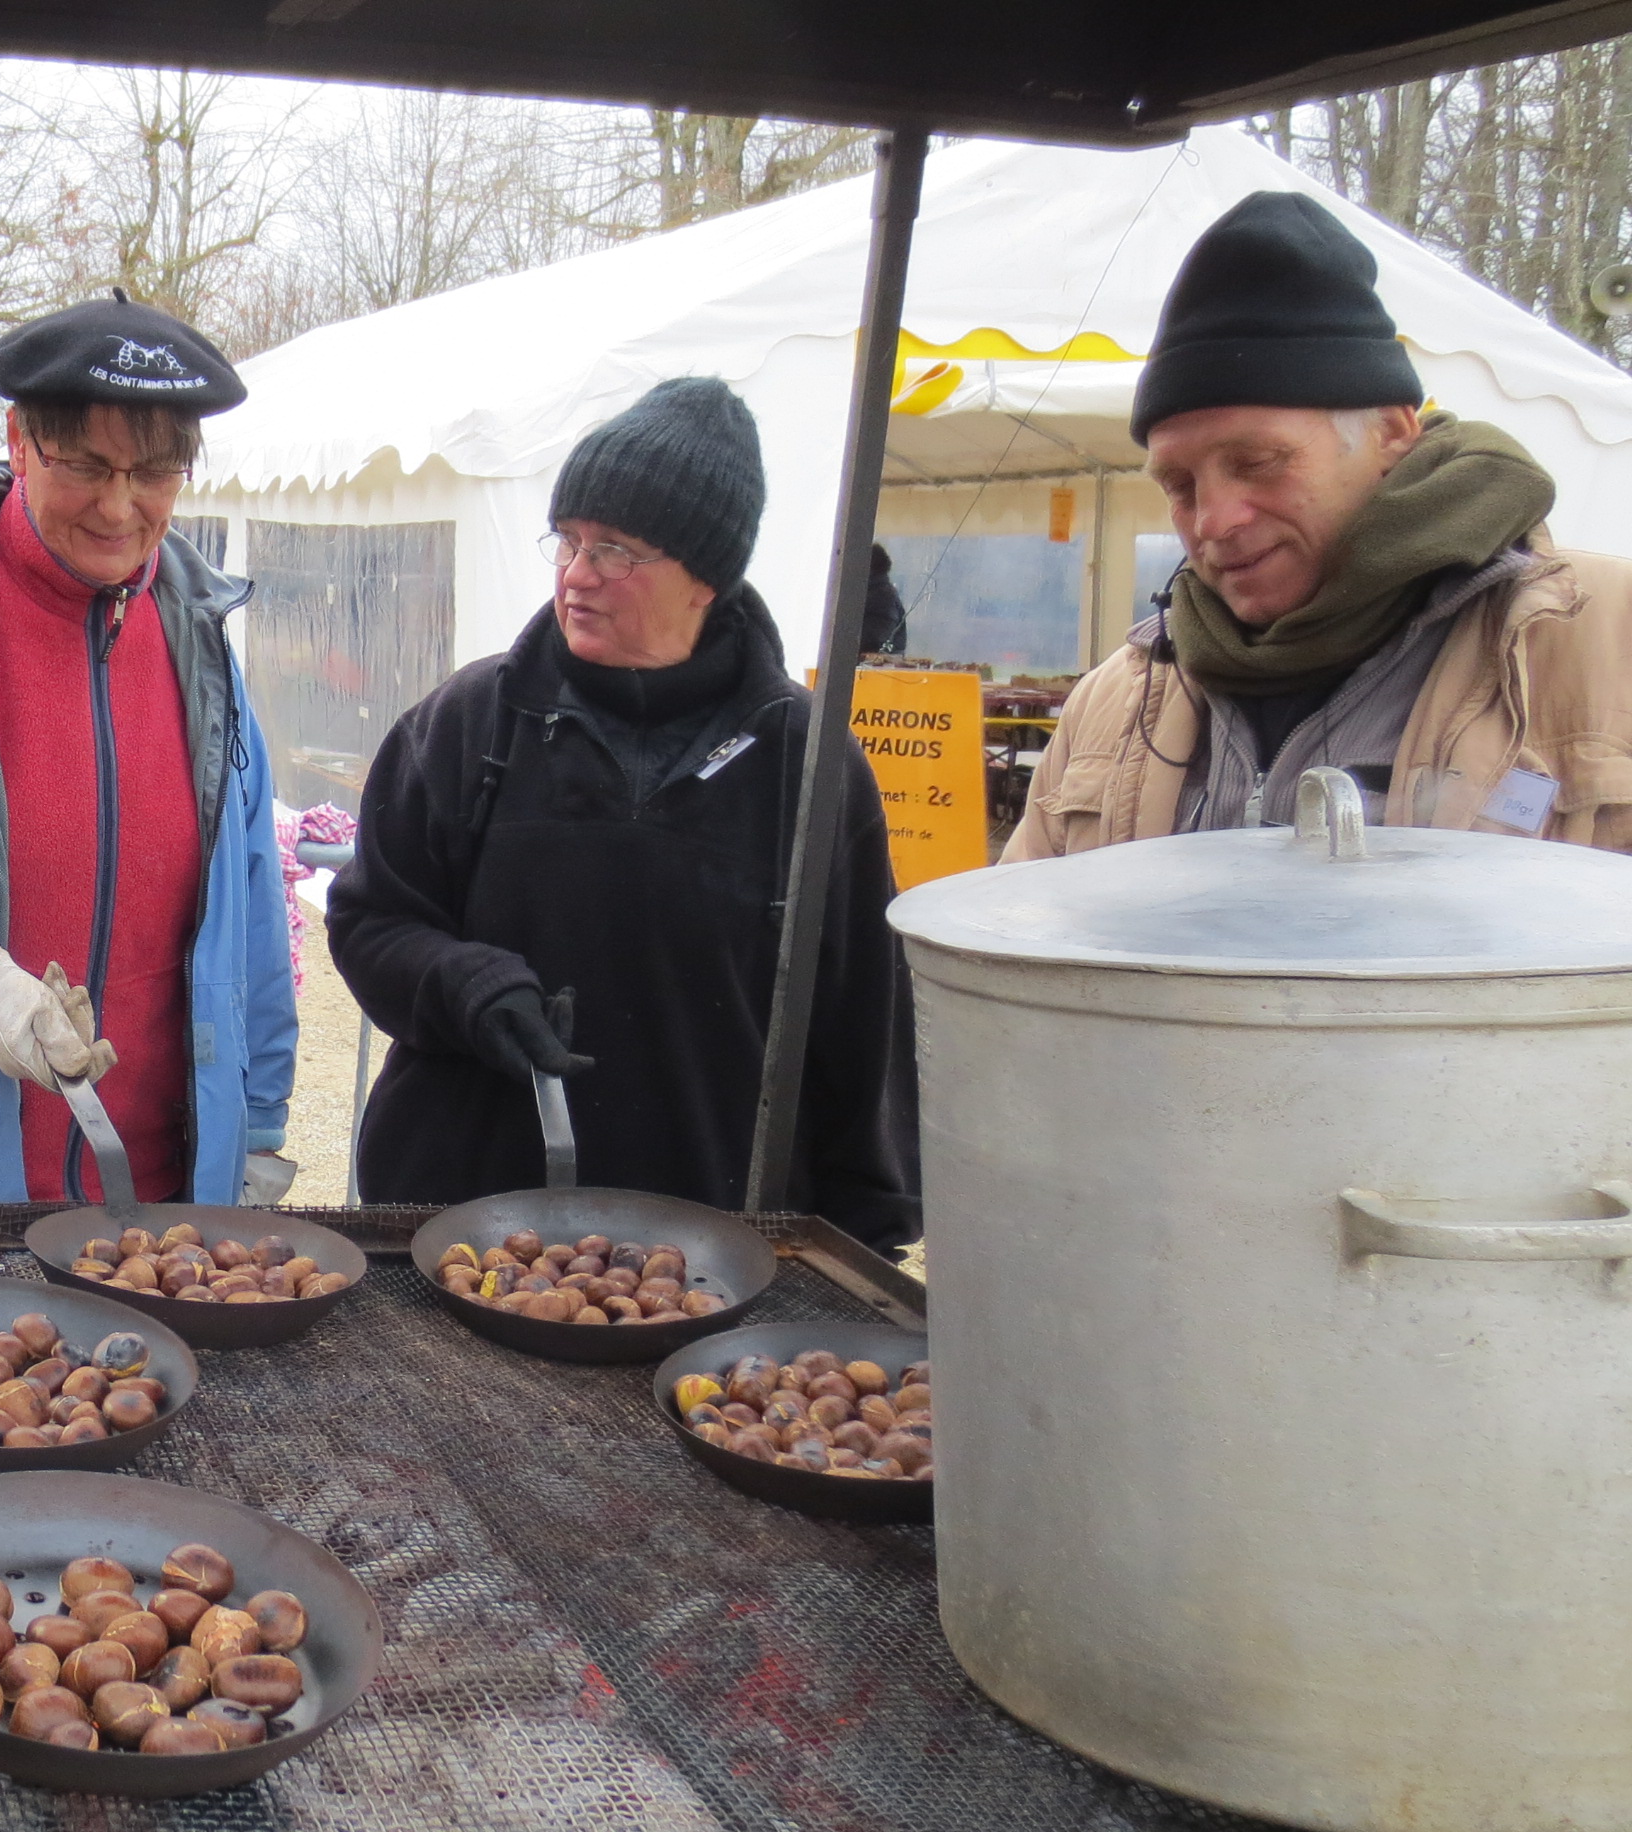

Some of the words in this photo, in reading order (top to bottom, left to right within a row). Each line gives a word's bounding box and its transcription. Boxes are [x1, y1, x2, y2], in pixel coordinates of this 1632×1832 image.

[89, 365, 108, 381] LES
[109, 373, 173, 390] CONTAMINES
[850, 708, 952, 732] ARRONS
[857, 736, 943, 759] HAUDS
[927, 785, 953, 807] 2€
[888, 827, 914, 839] rofit
[919, 829, 934, 840] de
